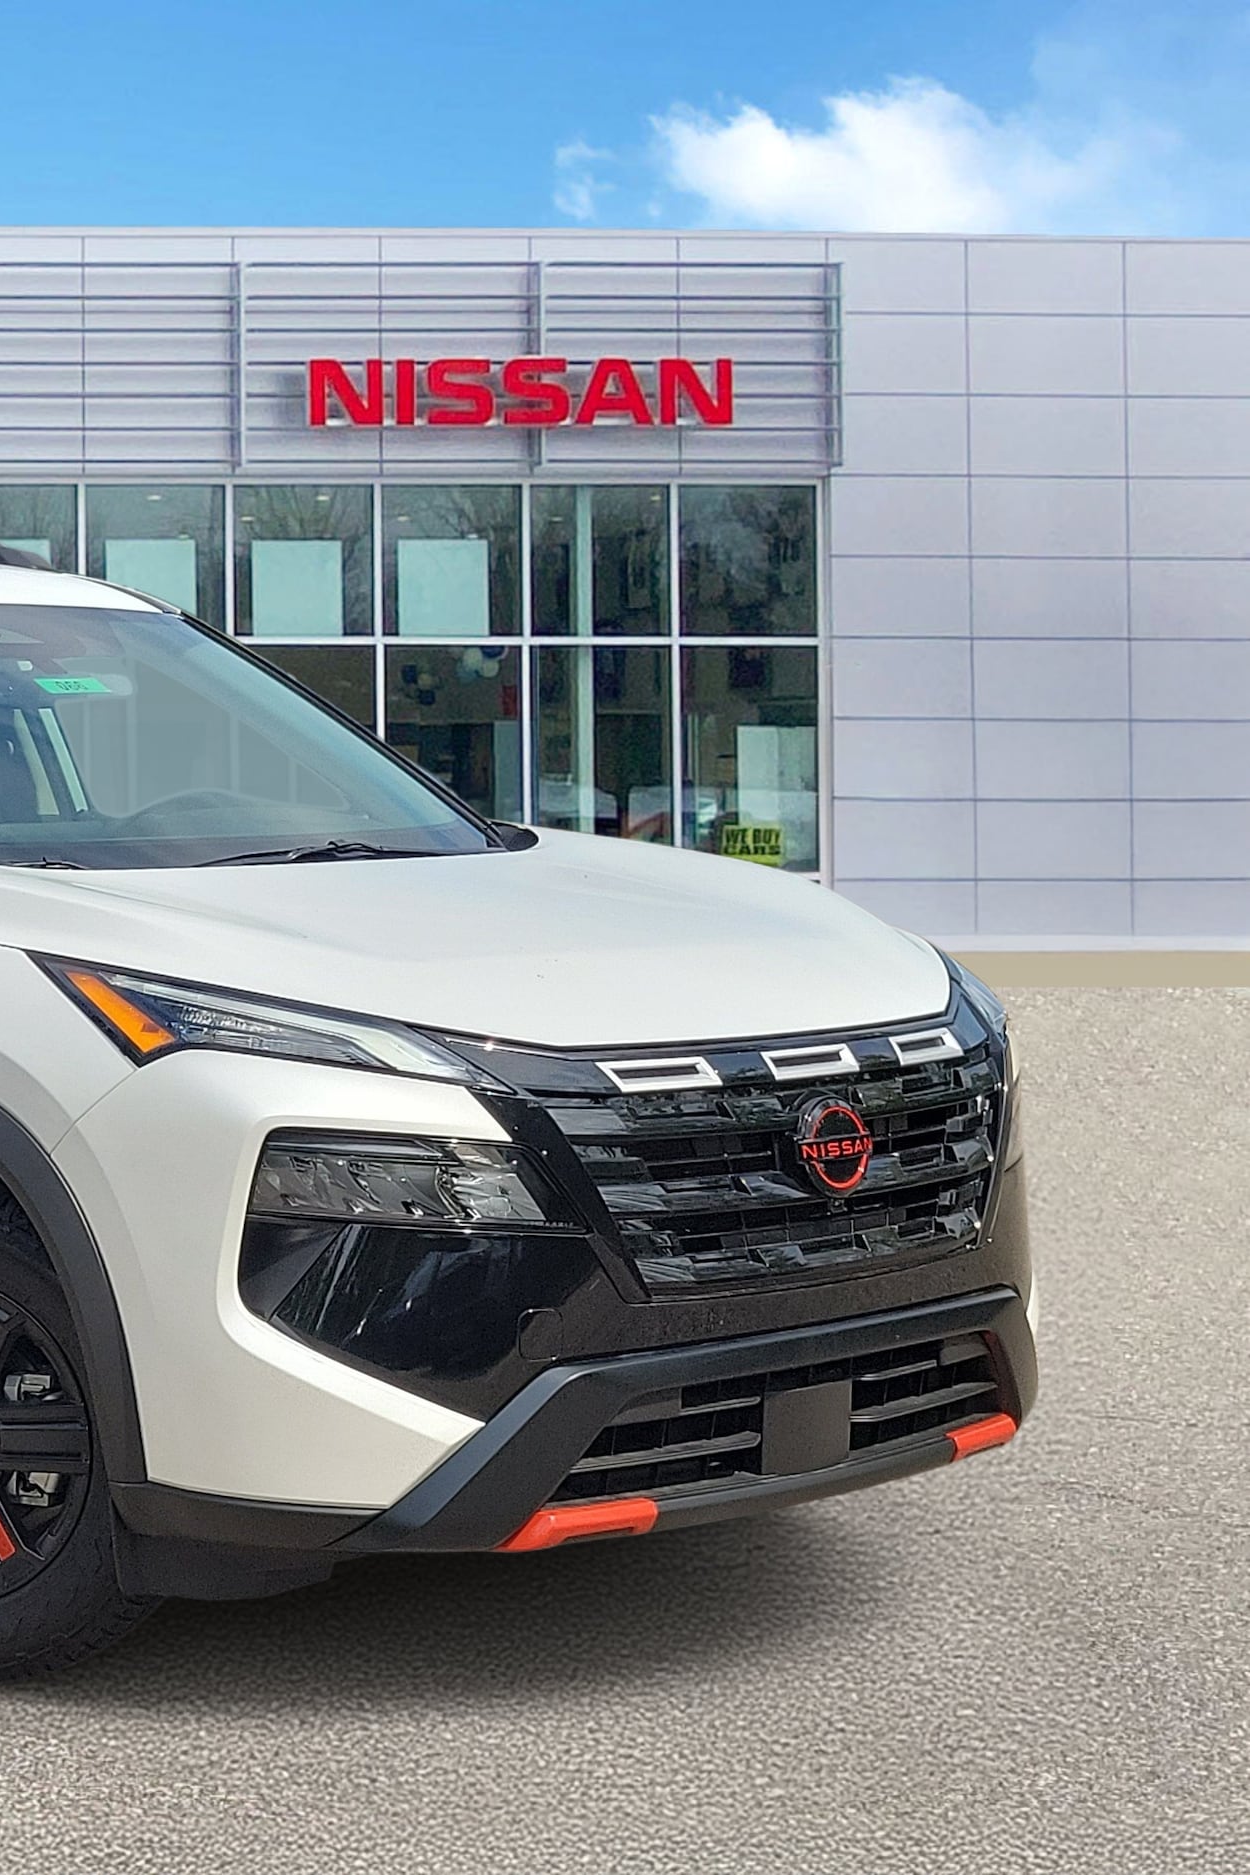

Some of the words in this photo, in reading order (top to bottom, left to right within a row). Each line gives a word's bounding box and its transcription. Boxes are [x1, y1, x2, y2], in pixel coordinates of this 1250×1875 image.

[308, 358, 733, 426] NISSAN
[725, 828, 747, 844] WE
[752, 828, 781, 844] BUY
[723, 845, 781, 855] CARS
[801, 1138, 873, 1159] NISSAN
